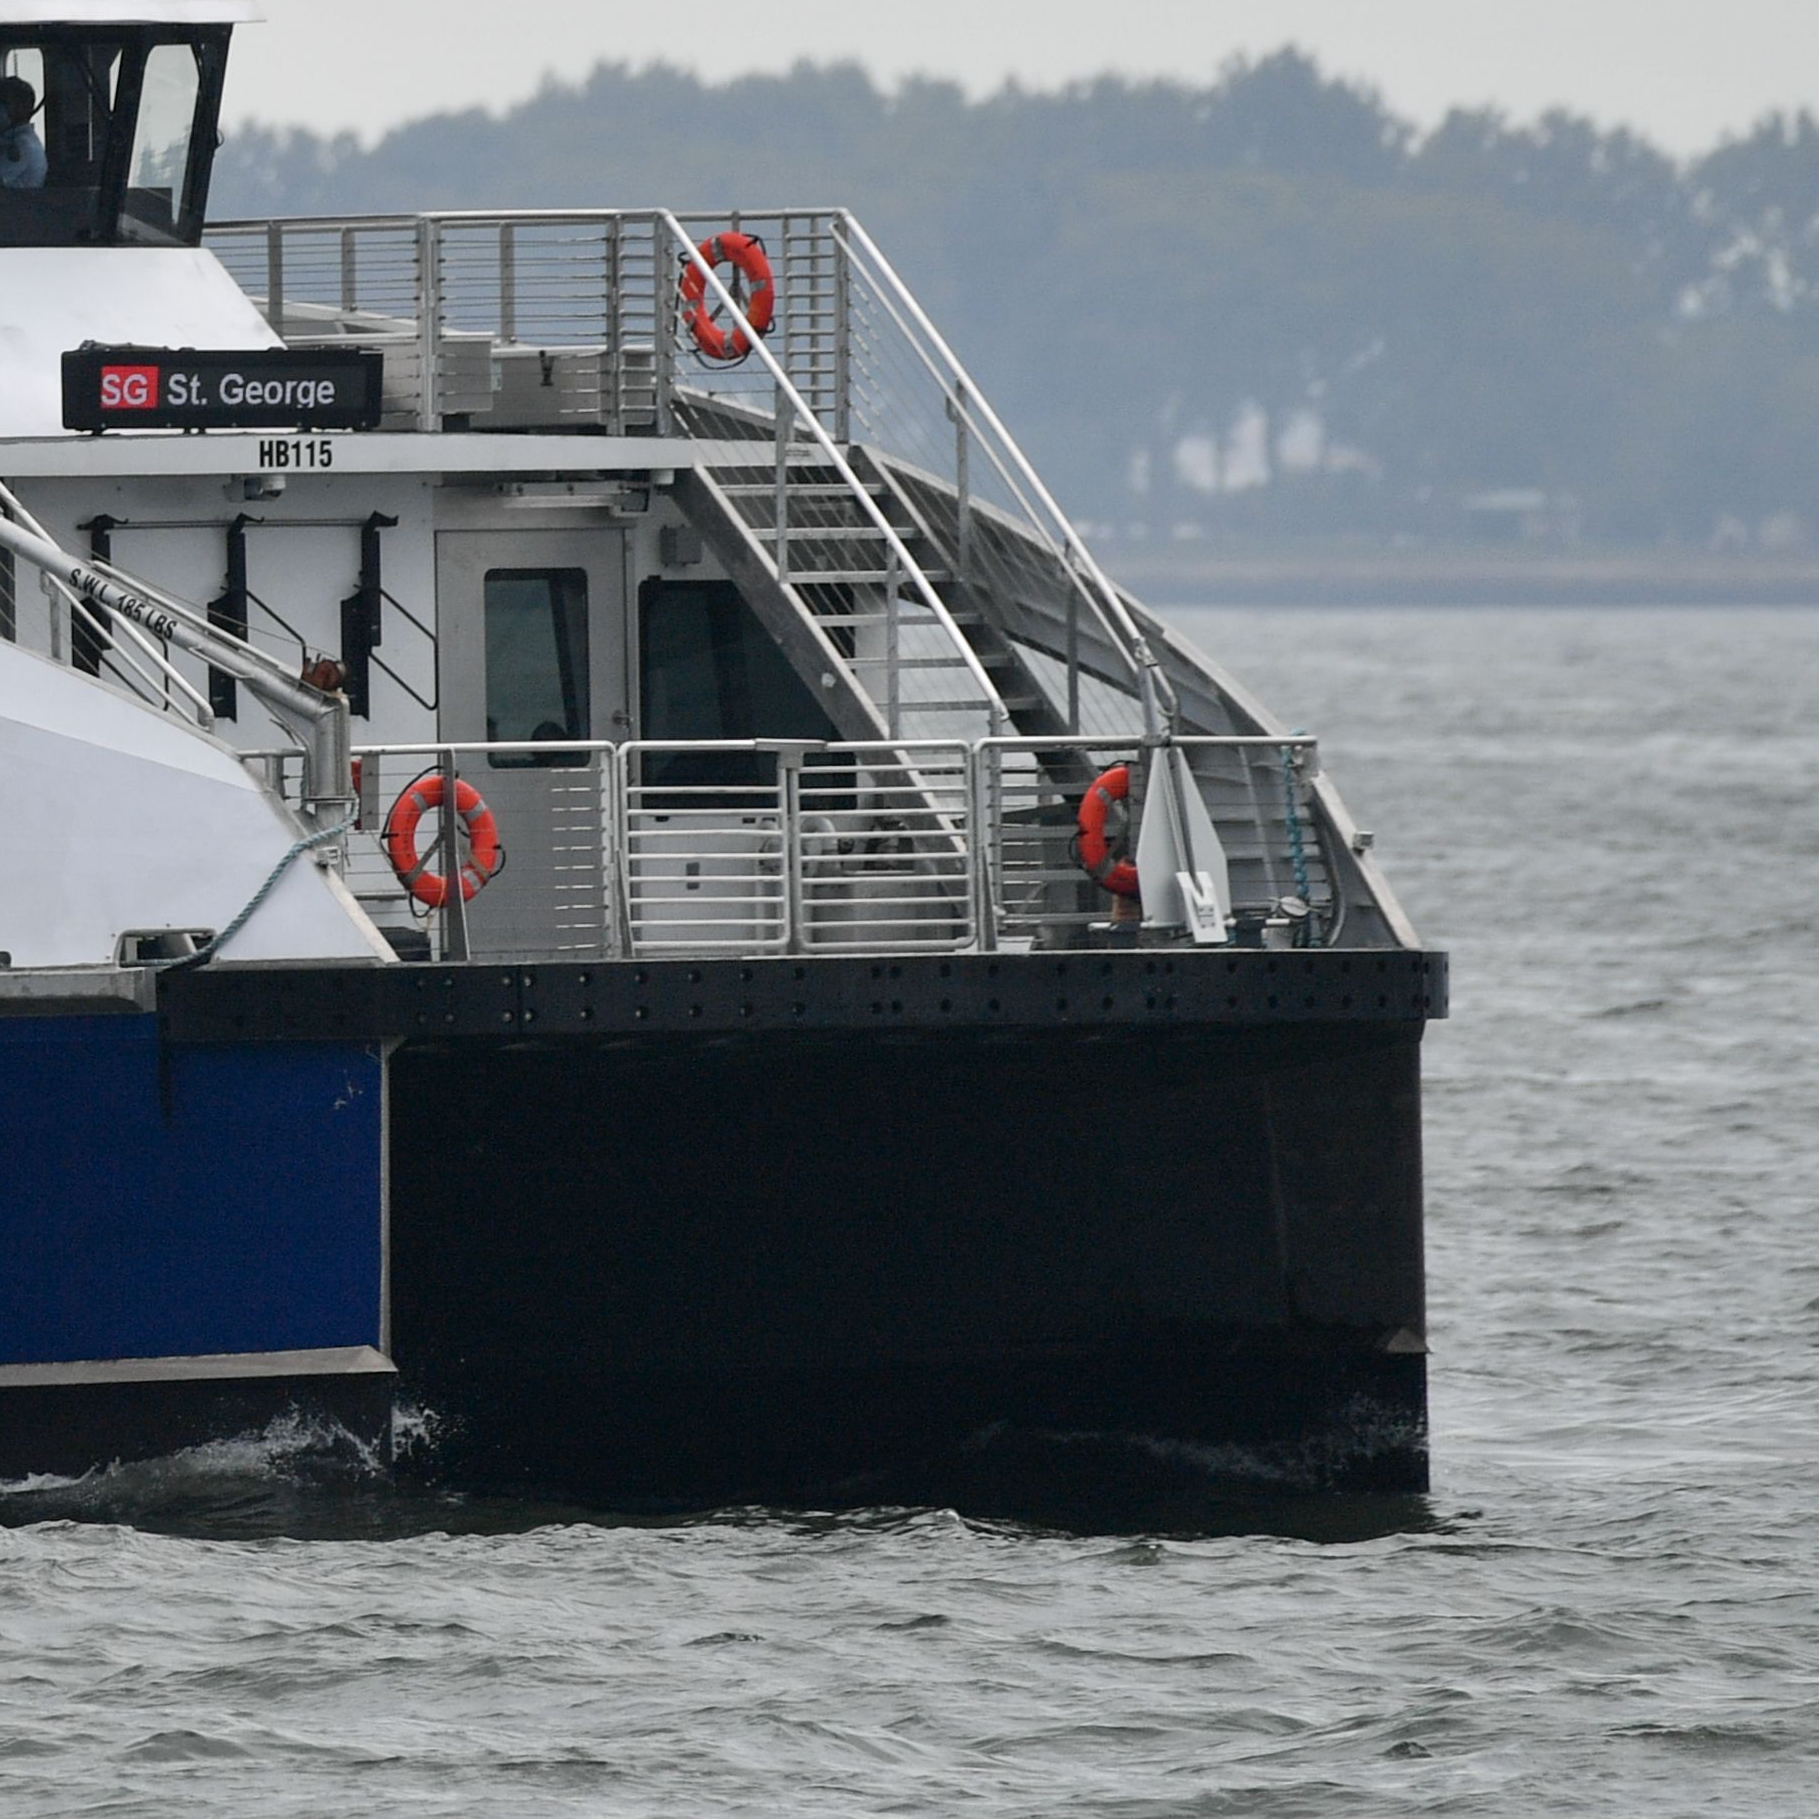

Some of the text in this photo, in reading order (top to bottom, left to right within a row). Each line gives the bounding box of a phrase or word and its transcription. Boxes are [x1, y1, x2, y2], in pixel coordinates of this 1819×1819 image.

[101, 373, 335, 408] SG St. George
[259, 440, 333, 468] HB115
[117, 594, 146, 622] 185
[145, 609, 178, 640] LBS
